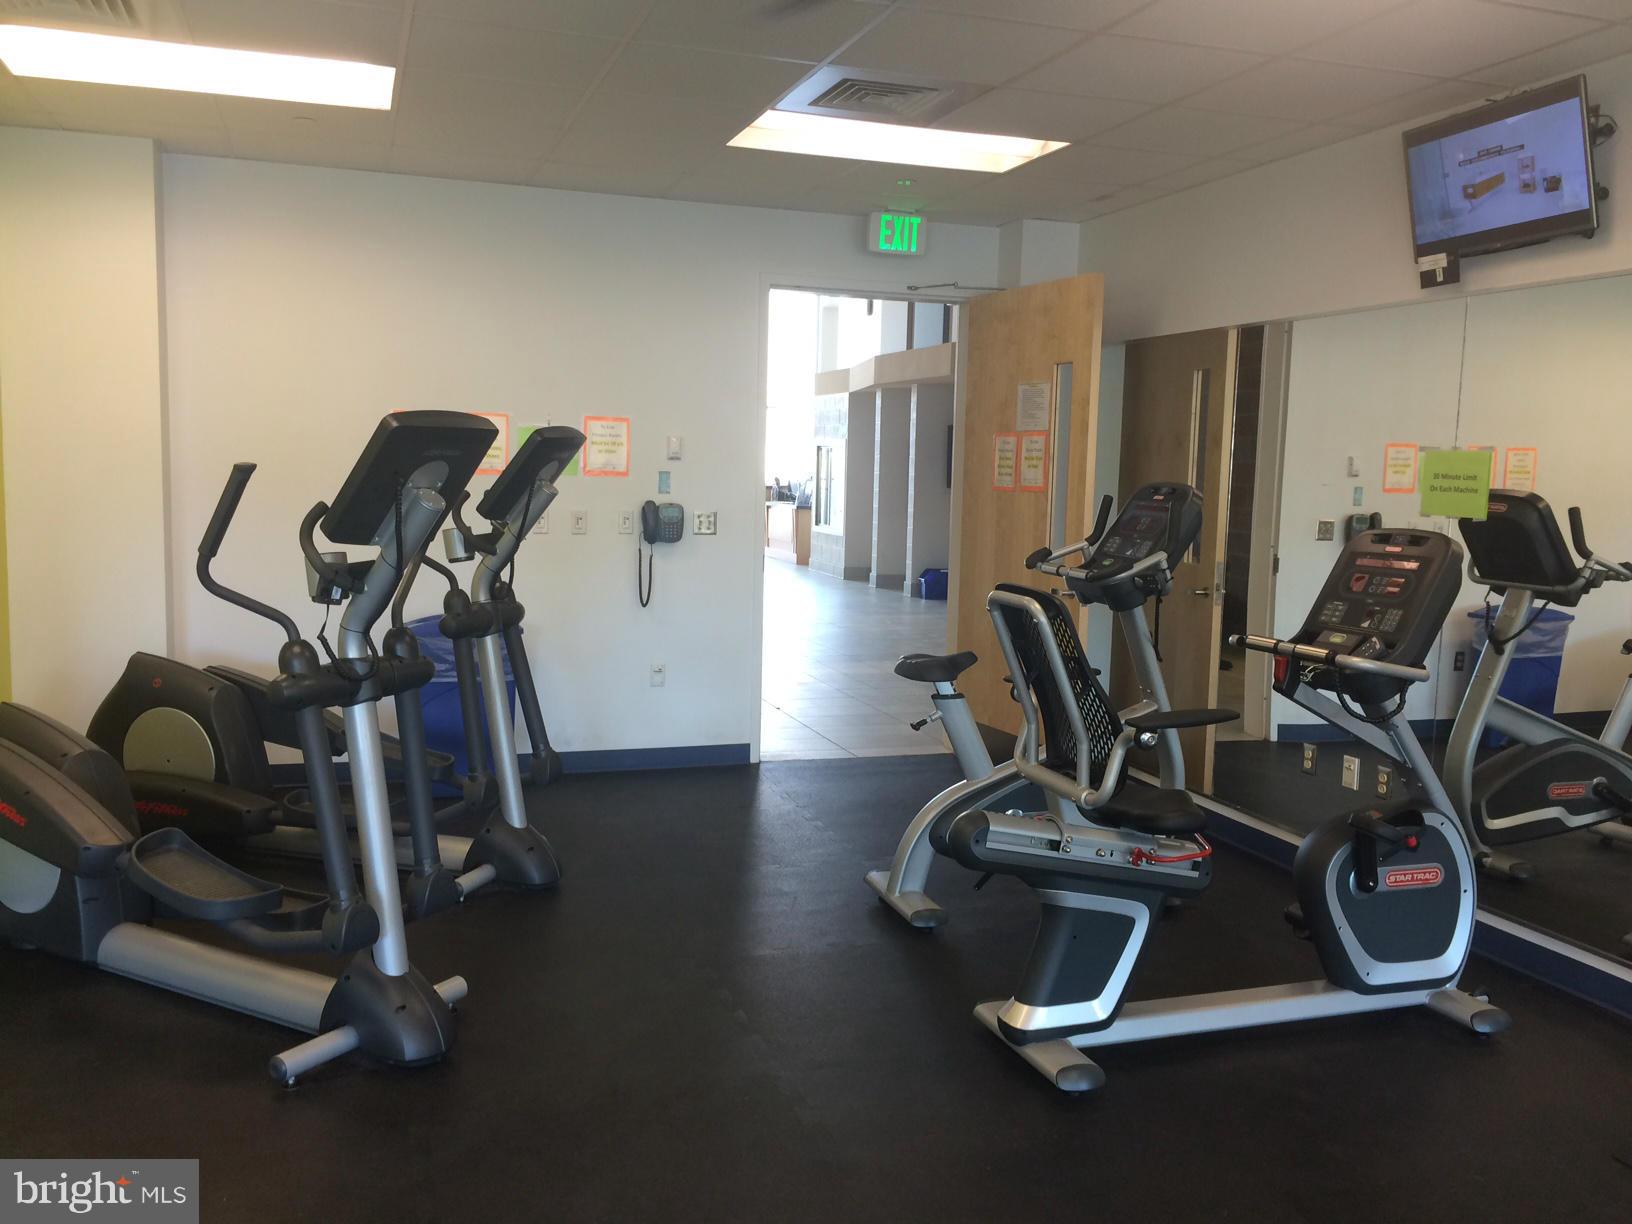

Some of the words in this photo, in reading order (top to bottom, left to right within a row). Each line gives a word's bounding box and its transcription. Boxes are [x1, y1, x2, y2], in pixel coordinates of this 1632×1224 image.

[880, 214, 921, 252] EXIT
[1441, 472, 1461, 481] Minute
[1462, 472, 1478, 481] Limit
[1439, 485, 1452, 493] Each
[1453, 486, 1479, 494] Machine
[1389, 874, 1412, 882] STAR
[1413, 871, 1437, 880] TRAC
